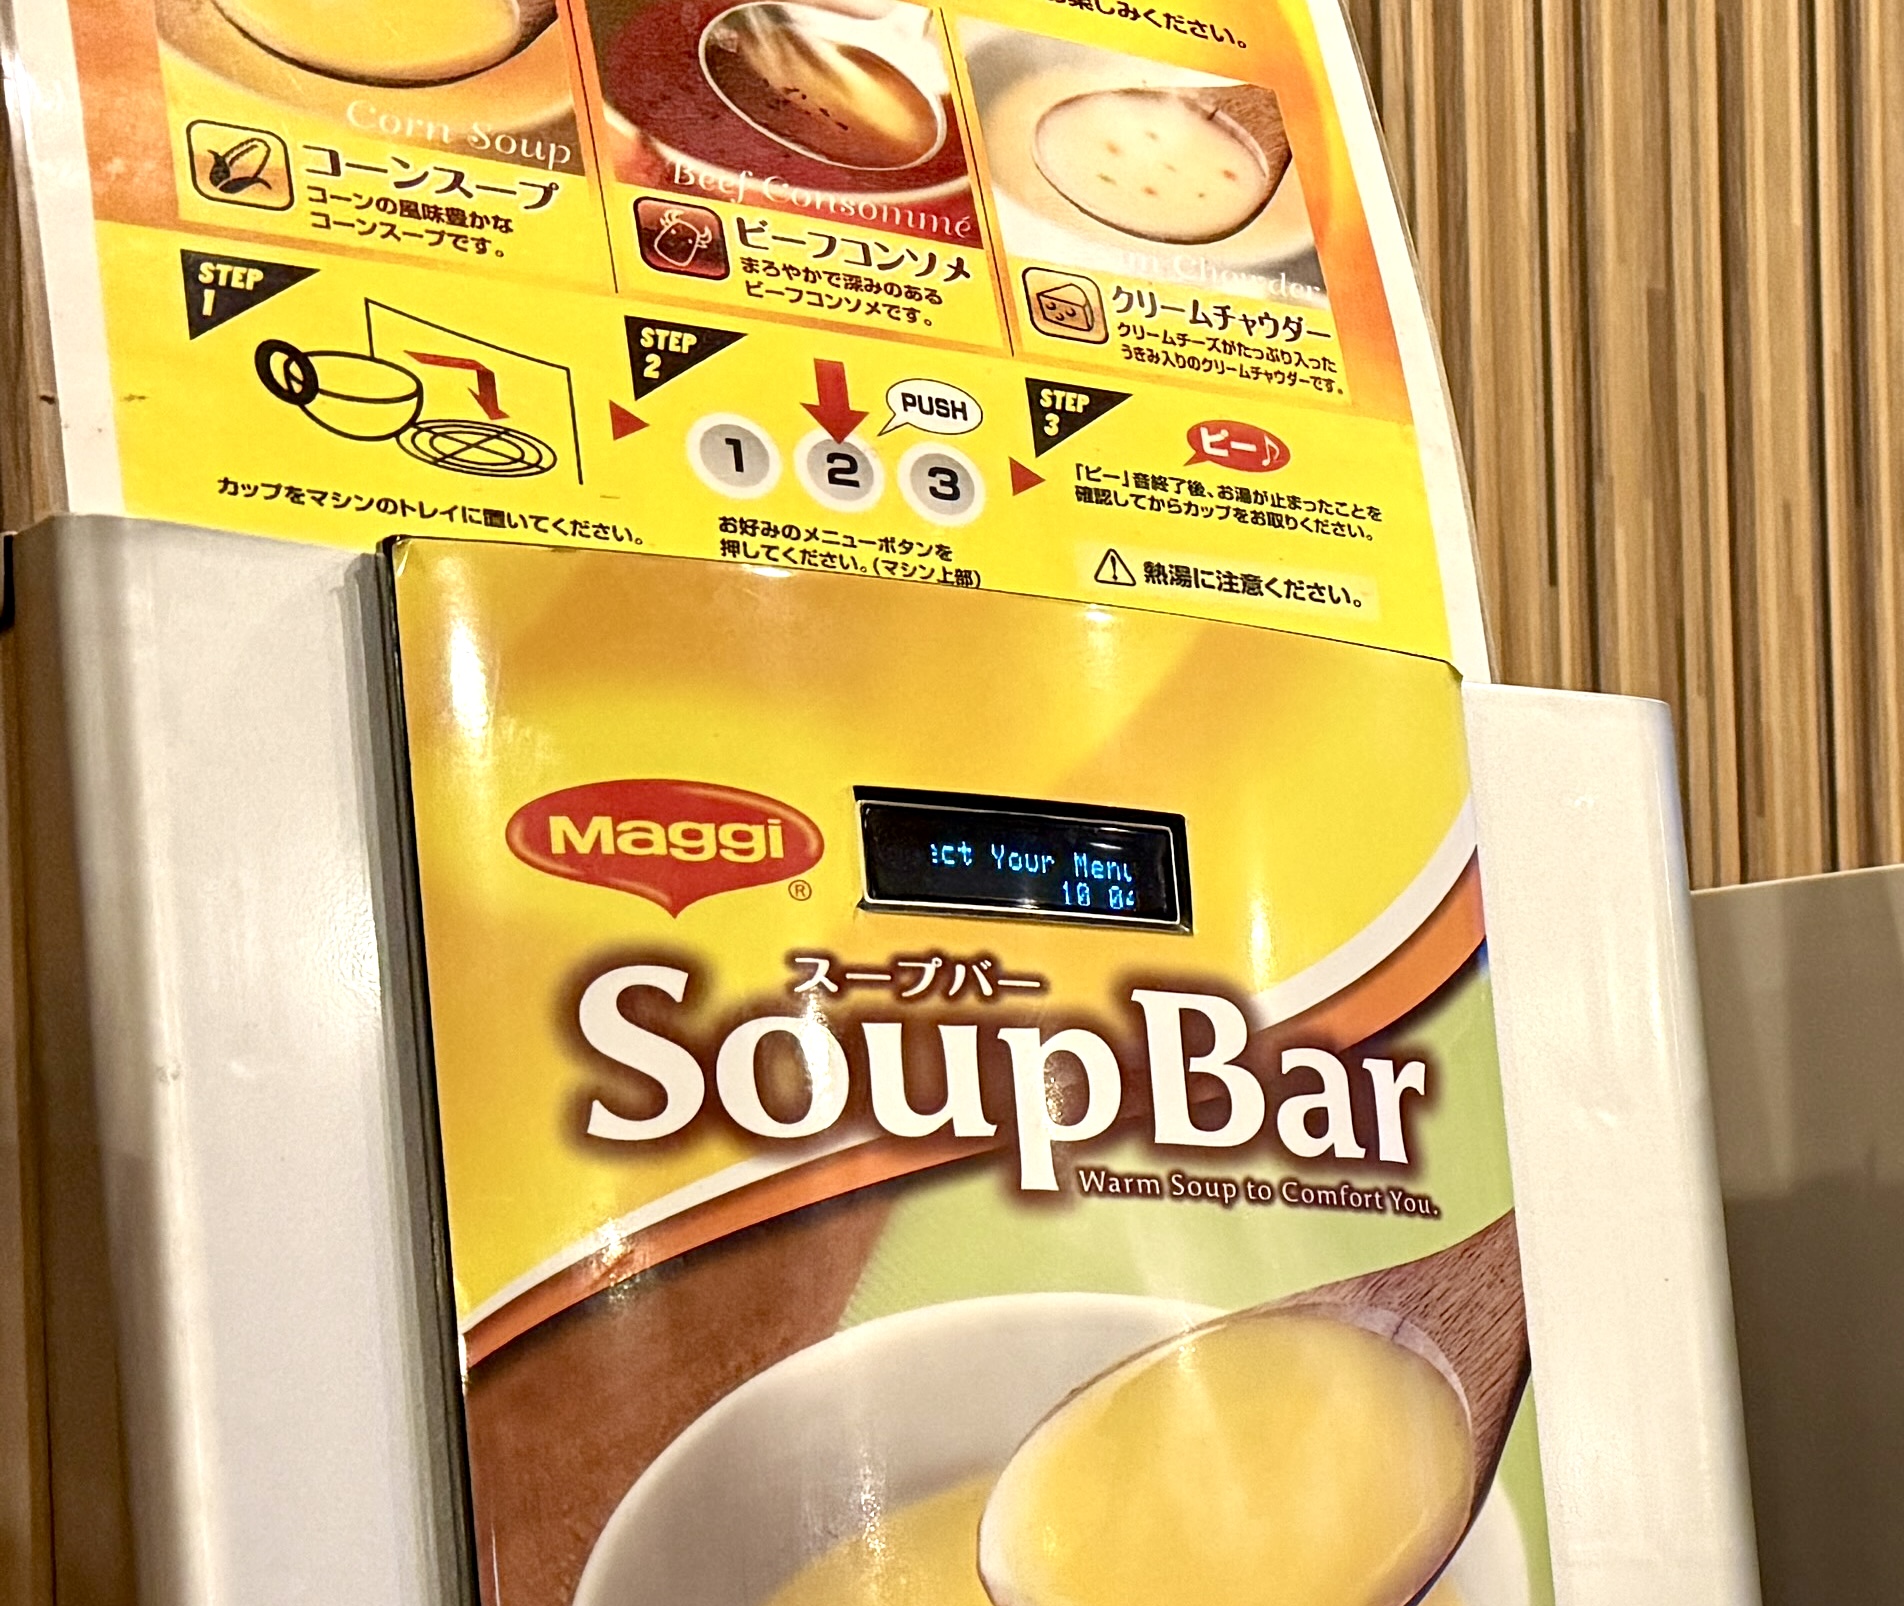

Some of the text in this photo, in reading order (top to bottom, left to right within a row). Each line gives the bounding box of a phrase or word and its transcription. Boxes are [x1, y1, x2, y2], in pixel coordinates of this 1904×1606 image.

[1050, 0, 1247, 48] しみください。
[346, 99, 573, 171] Corn Soup
[302, 145, 560, 210] コーンスープ
[673, 160, 971, 240] Beef Consommé
[306, 185, 514, 235] コーンの風味豊かな
[310, 212, 506, 259] コーンスープです。
[735, 216, 971, 283] ビーフコンソメ
[198, 261, 265, 292] STEP
[740, 257, 943, 305] まろやかで深みのある
[201, 289, 214, 317] 1
[745, 281, 933, 327] ビーフコンソメです。
[1112, 286, 1331, 342] クリームチャウダー
[639, 326, 698, 354] STEP
[1117, 321, 1338, 374] クリームチーズがたっぷり入った
[643, 355, 661, 380] 2
[900, 392, 968, 422] PUSH
[1039, 388, 1090, 414] STEP
[1043, 413, 1060, 437] 3
[724, 438, 961, 502] 1 2 3
[216, 475, 646, 546] カップをマシンのトレイに置いてください。
[718, 515, 953, 562] お好みのメニューボタンを
[1143, 560, 1363, 608] 熱湯に注意ください。
[548, 815, 785, 863] Maggi
[991, 843, 1055, 874] Your
[794, 956, 1042, 998] スープバー
[1078, 1168, 1440, 1217] Warm Soup to Comfort You.
